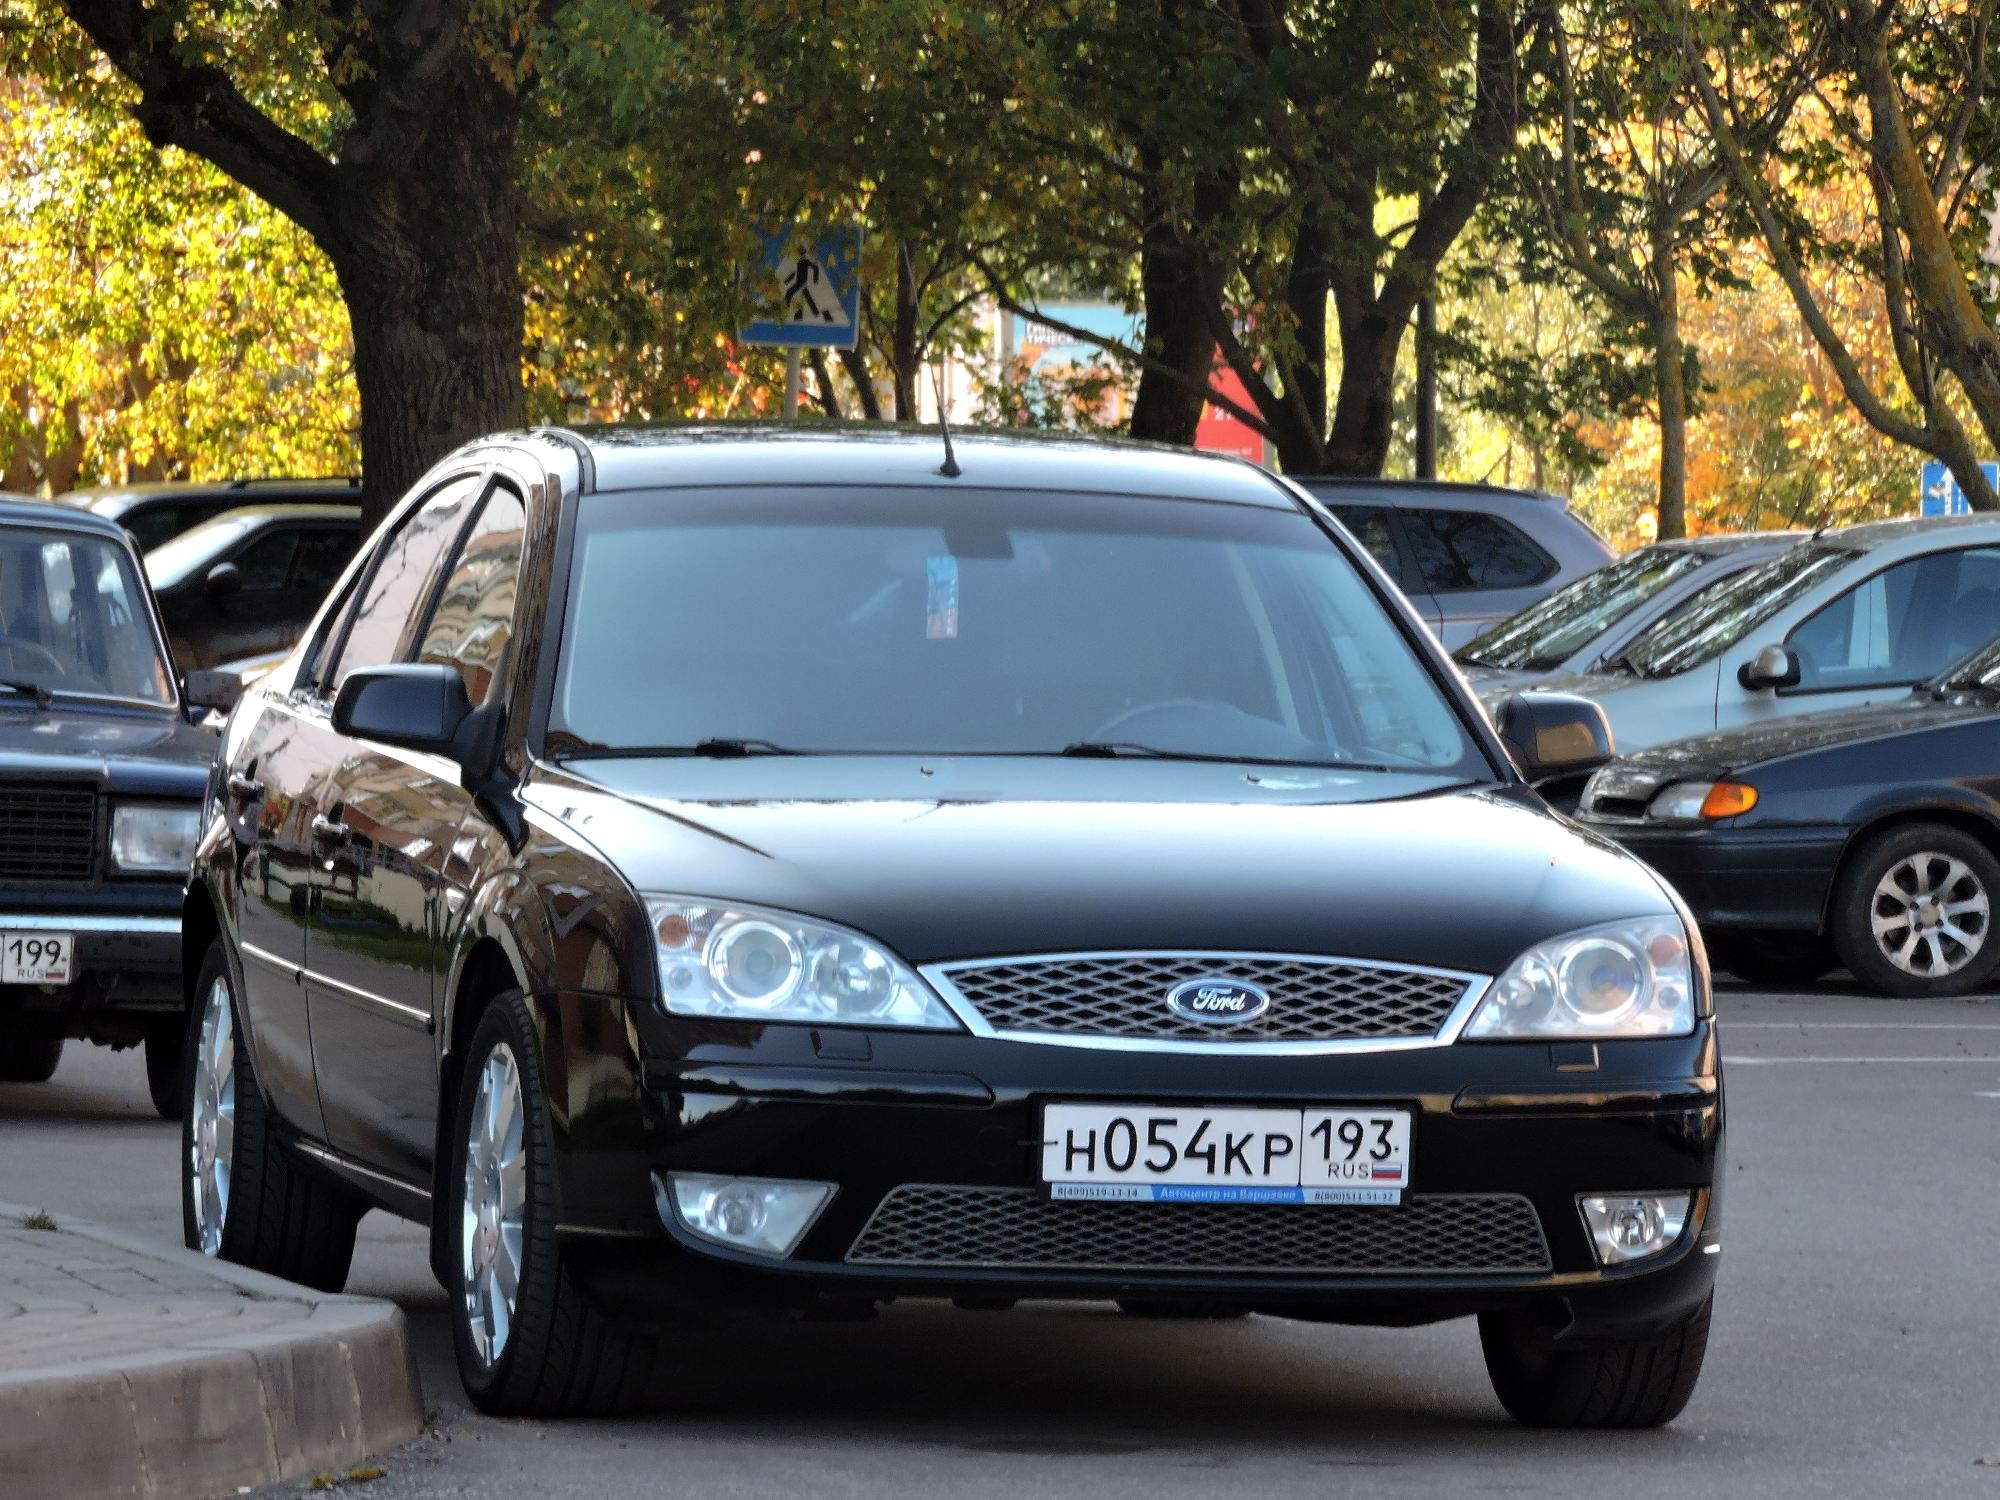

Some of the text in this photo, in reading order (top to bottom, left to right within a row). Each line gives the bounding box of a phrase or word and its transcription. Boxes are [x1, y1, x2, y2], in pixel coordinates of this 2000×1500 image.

[9, 939, 61, 966] 199
[18, 968, 45, 978] RUS
[1193, 988, 1246, 1011] Ford
[1310, 1118, 1393, 1160] 193
[1328, 1163, 1368, 1178] RUS
[1160, 1186, 1220, 1202] Автоцентр
[1223, 1190, 1237, 1200] на
